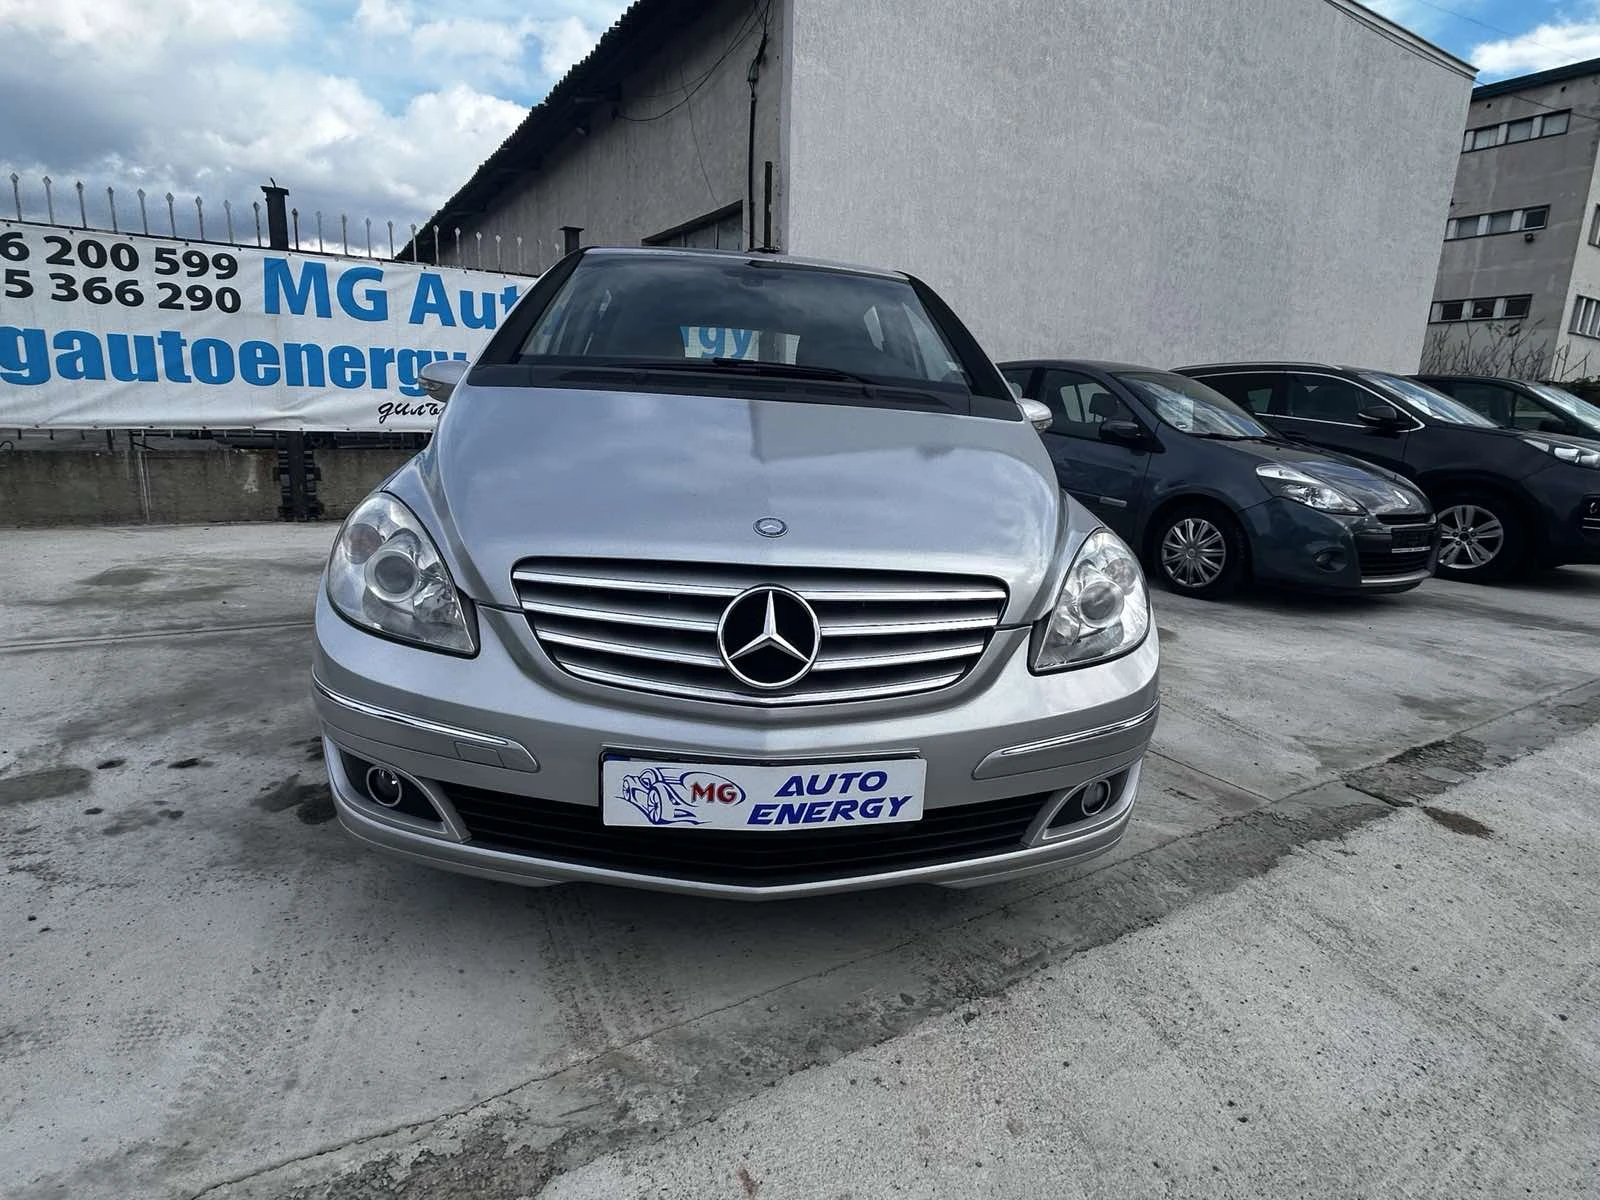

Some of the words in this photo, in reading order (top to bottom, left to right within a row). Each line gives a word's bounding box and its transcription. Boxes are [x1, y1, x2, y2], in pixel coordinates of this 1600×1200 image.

[0, 231, 30, 262] 6
[43, 235, 140, 272] 200
[154, 246, 239, 280] 599
[5, 268, 34, 299] 5
[49, 272, 145, 307] 366
[156, 282, 242, 314] 290
[263, 256, 389, 323] MG
[690, 781, 738, 804] MG
[774, 771, 888, 797] AUTO
[747, 795, 913, 825] ENERGY
